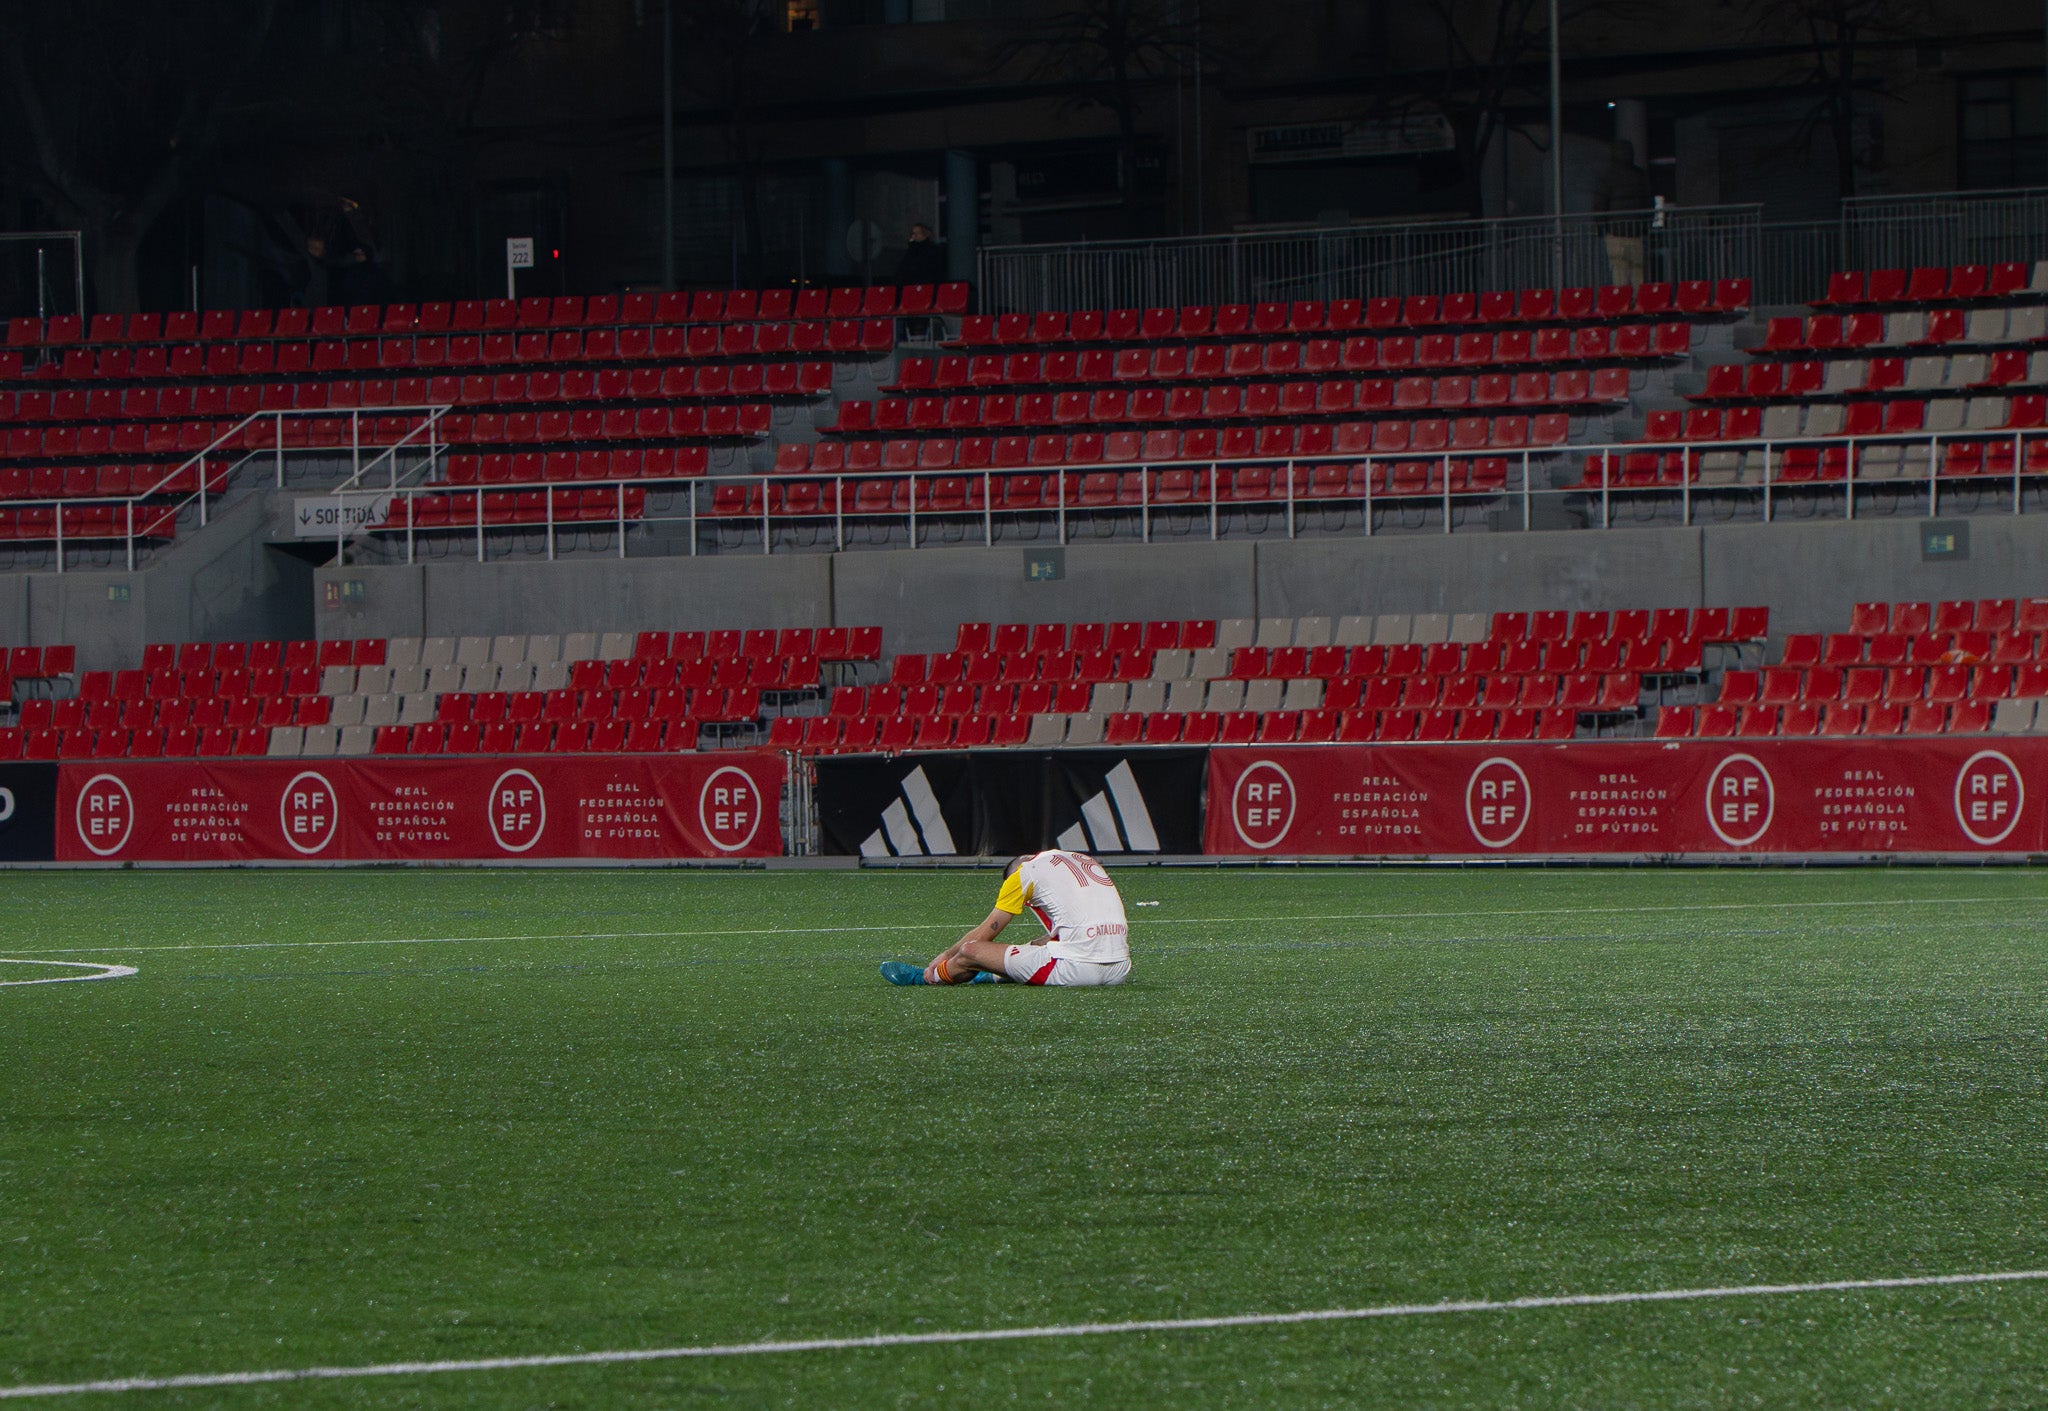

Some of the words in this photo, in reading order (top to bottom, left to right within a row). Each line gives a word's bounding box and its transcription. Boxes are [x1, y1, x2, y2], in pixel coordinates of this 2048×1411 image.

[512, 252, 529, 264] 222
[1361, 776, 1400, 787] REAL
[1598, 773, 1639, 785] REAL
[1843, 769, 1885, 781] REAL
[606, 782, 640, 793] REAL
[1482, 780, 1516, 799] RF
[1723, 777, 1759, 796] RF
[1972, 774, 2008, 794] RF
[191, 787, 225, 798] REAL
[394, 786, 429, 797] REAL
[502, 790, 533, 807] RF
[715, 788, 747, 805] RF
[1248, 783, 1282, 801] RF
[1333, 790, 1429, 803] FEDERACIÓN
[1569, 787, 1668, 801] FEDERACIÓN
[1814, 784, 1915, 799] FEDERACIÓN
[90, 795, 121, 812] RF
[166, 800, 249, 813] FEDERACIÓN
[294, 792, 325, 809] RF
[369, 798, 455, 812] FEDERACIÓN
[578, 794, 665, 808] FEDERACIÓN
[1341, 806, 1420, 819] ESPAÑOLA
[1482, 806, 1516, 824] EF
[1577, 804, 1658, 818] ESPAÑOLA
[1723, 803, 1759, 822] EF
[1822, 801, 1906, 815] ESPAÑOLA
[1972, 801, 2008, 821] EF
[172, 815, 241, 828] ESPAÑOLA
[294, 815, 325, 833] EF
[377, 814, 447, 827] ESPAÑOLA
[503, 813, 531, 831] EF
[586, 811, 658, 824] ESPAÑOLA
[715, 812, 747, 829] EF
[1247, 808, 1281, 826] EF
[91, 818, 121, 835] EF
[1338, 824, 1357, 836] DE
[1364, 823, 1422, 835] FÚTBOL
[1574, 823, 1594, 834] DE
[1600, 820, 1660, 834] FÚTBOL
[1819, 820, 1840, 832] DE
[1846, 818, 1908, 832] FÚTBOL
[171, 832, 188, 843] DE
[193, 830, 245, 843] FÚTBOL
[376, 831, 393, 841] DE
[398, 829, 451, 841] FÚTBOL
[584, 828, 602, 839] DE
[608, 826, 661, 839] FÚTBOL
[1049, 854, 1114, 887] 18
